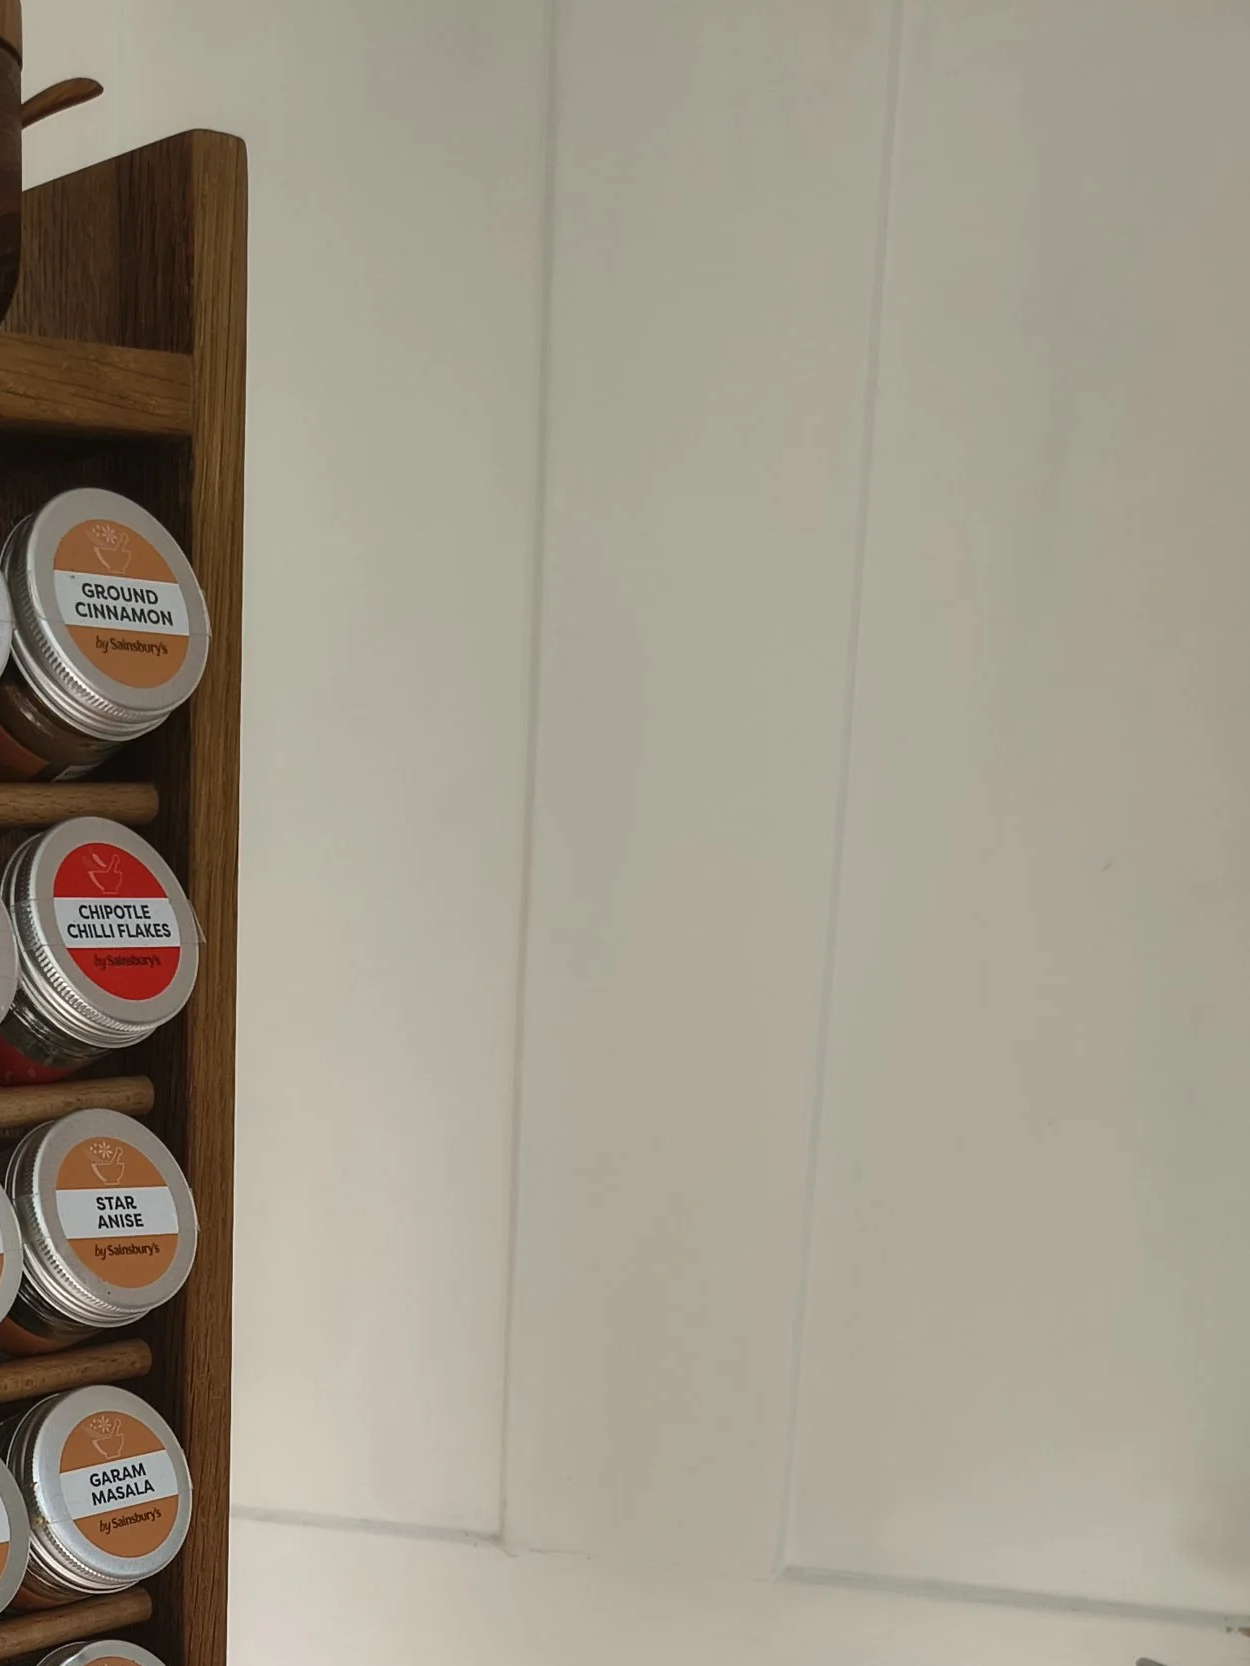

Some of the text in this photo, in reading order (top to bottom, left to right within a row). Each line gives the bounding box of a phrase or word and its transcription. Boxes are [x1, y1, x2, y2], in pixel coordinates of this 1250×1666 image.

[81, 582, 159, 605] GROUND
[75, 602, 174, 627] CINNAMON
[95, 636, 168, 656] by Sainsbury's
[78, 904, 152, 920] CHIPOTLE
[67, 922, 171, 939] CHILLI FLAKES
[94, 955, 162, 968] by Sainsbury's
[96, 1196, 137, 1211] STAR
[97, 1213, 144, 1229] ANISE
[95, 1243, 160, 1259] by Sainsbury's
[89, 1463, 147, 1487] GARAM
[92, 1480, 155, 1506] MASALA
[100, 1508, 161, 1533] by Sainsbury's
